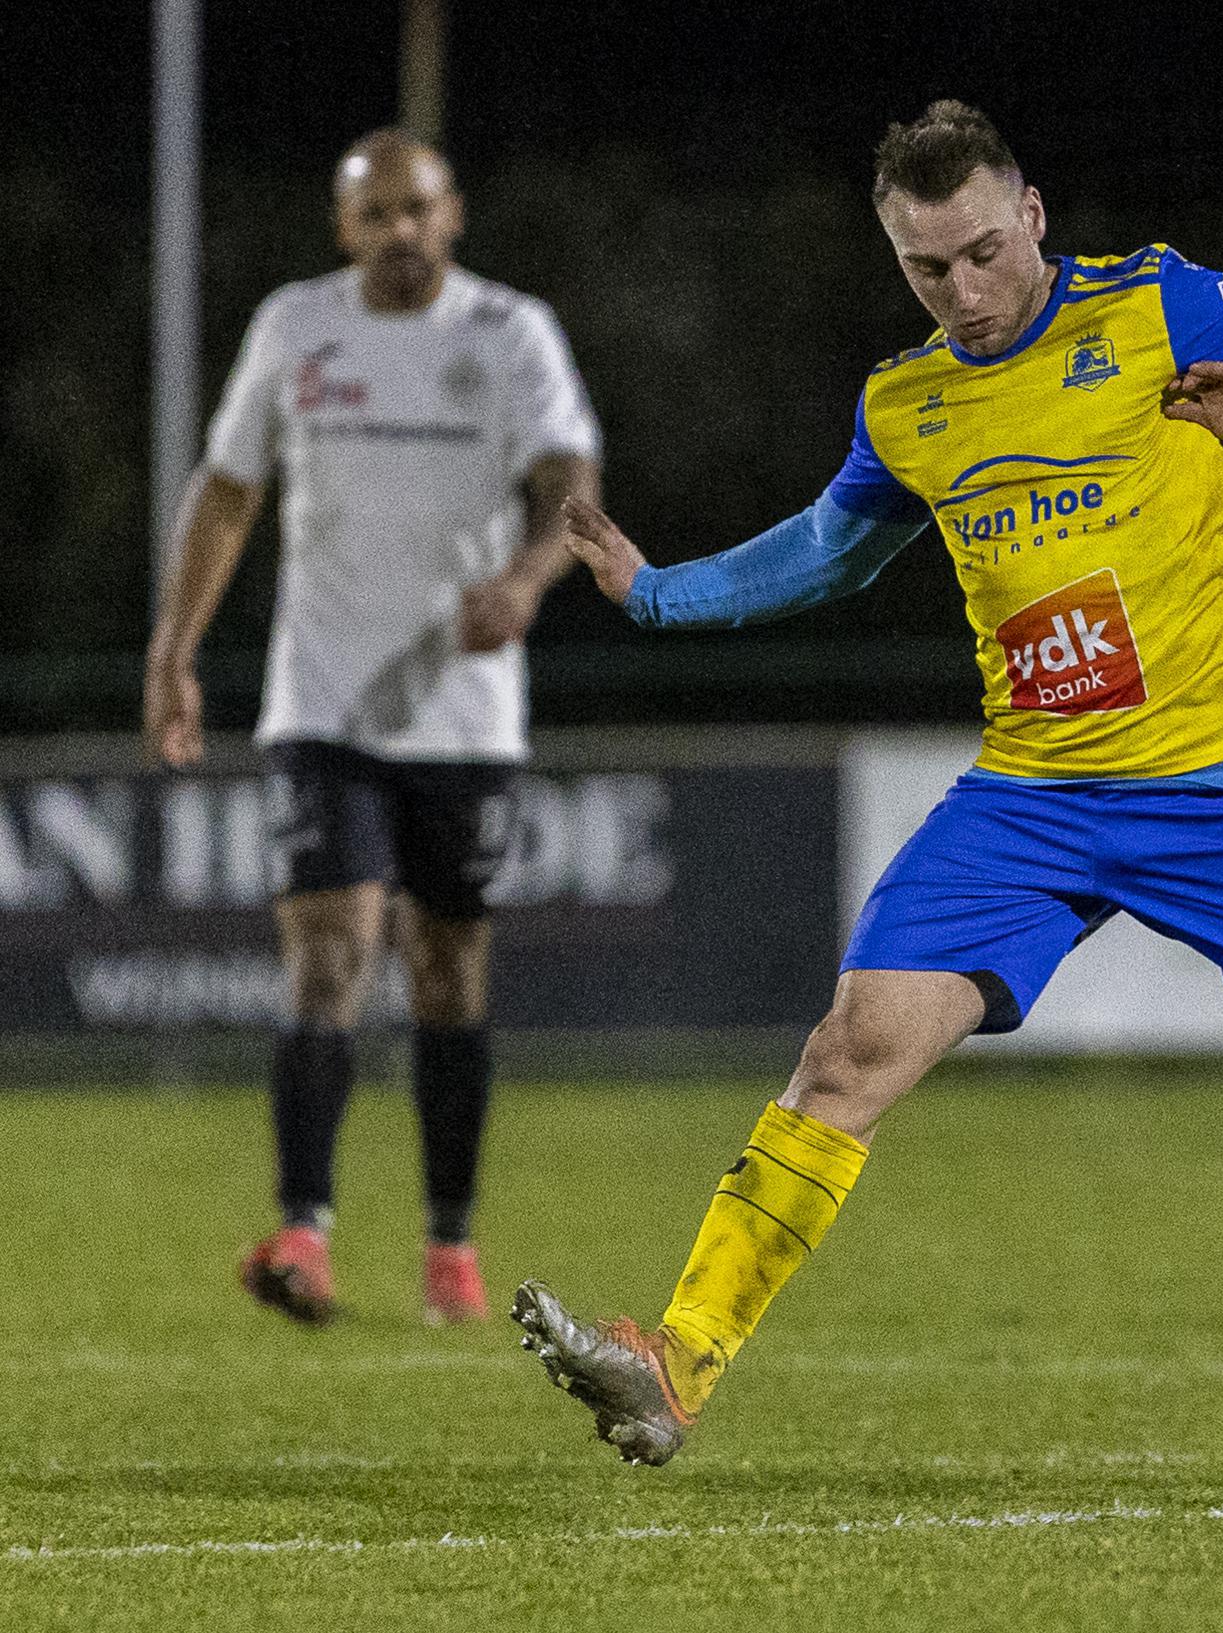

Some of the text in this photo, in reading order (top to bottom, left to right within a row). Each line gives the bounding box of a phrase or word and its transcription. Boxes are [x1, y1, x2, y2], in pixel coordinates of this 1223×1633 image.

[1029, 482, 1104, 525] hoe
[1011, 607, 1121, 682] vdk
[1036, 666, 1108, 706] bank
